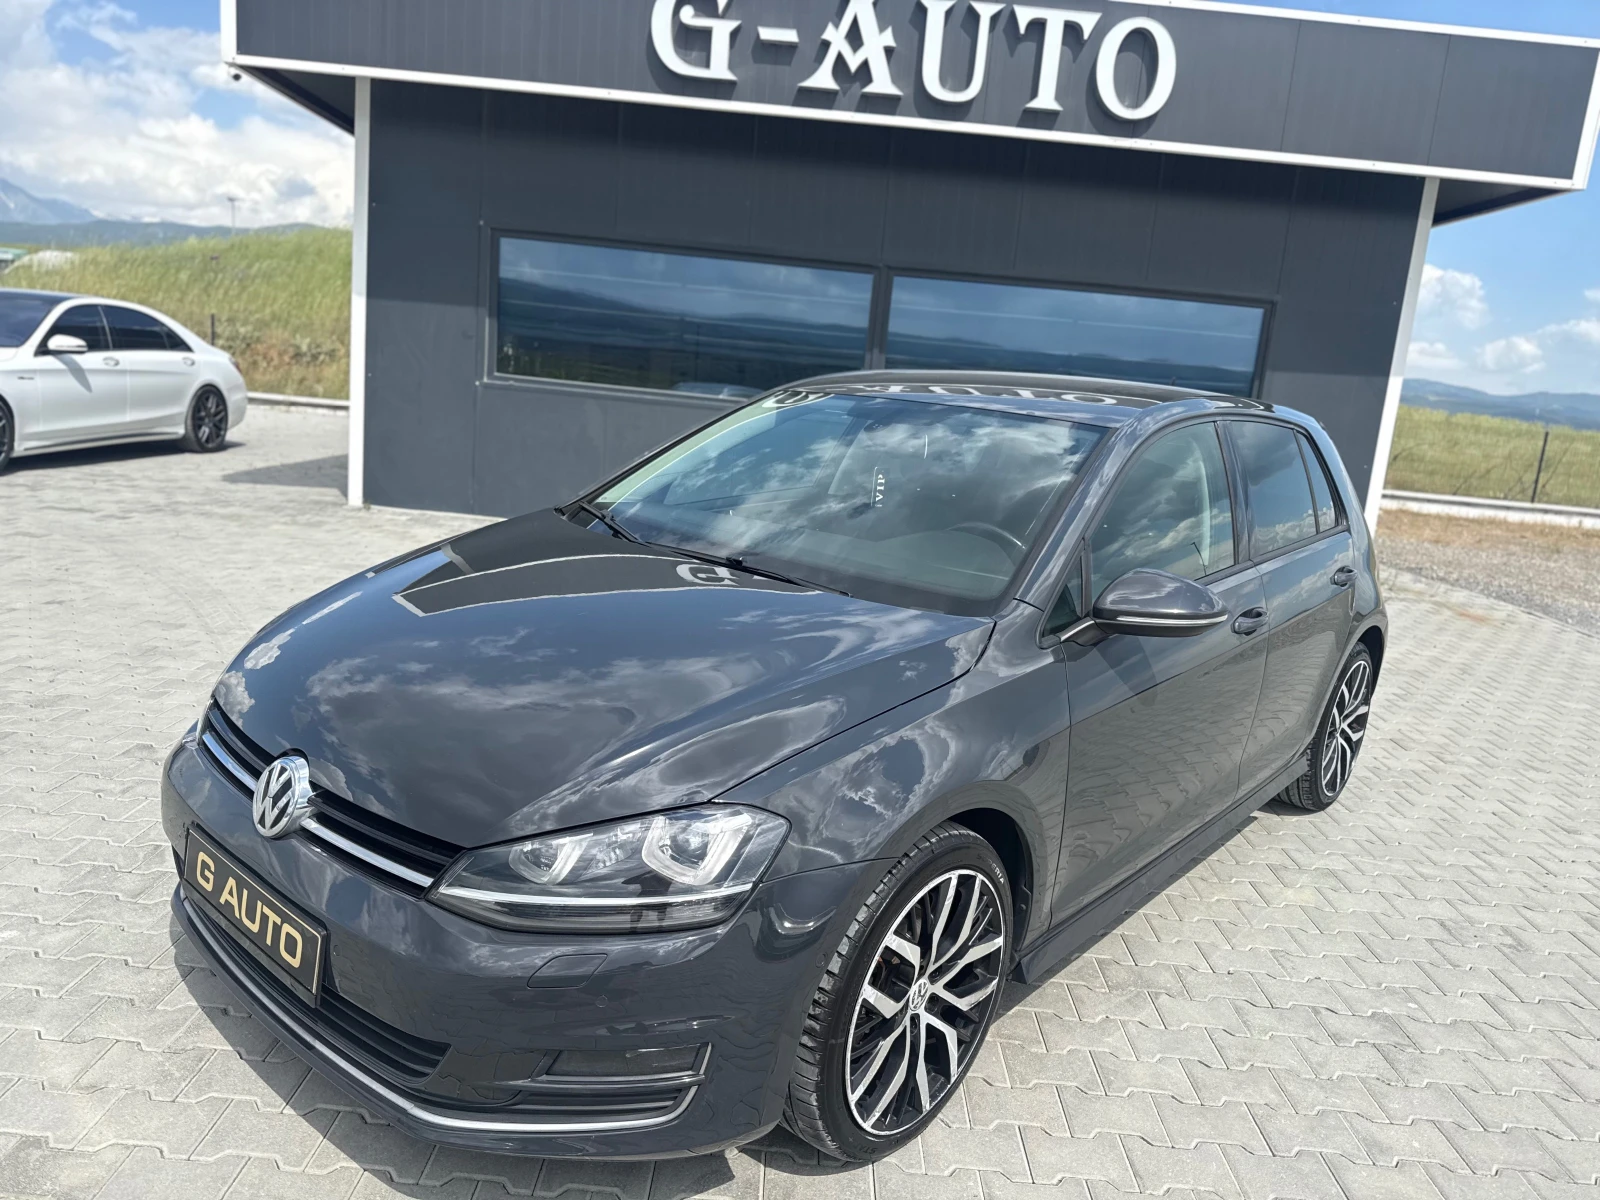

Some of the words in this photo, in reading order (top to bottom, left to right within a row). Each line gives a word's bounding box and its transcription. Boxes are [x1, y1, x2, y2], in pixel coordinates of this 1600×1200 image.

[650, 0, 1177, 121] G-AUTO
[196, 851, 215, 892] G
[219, 876, 303, 968] AUTO
